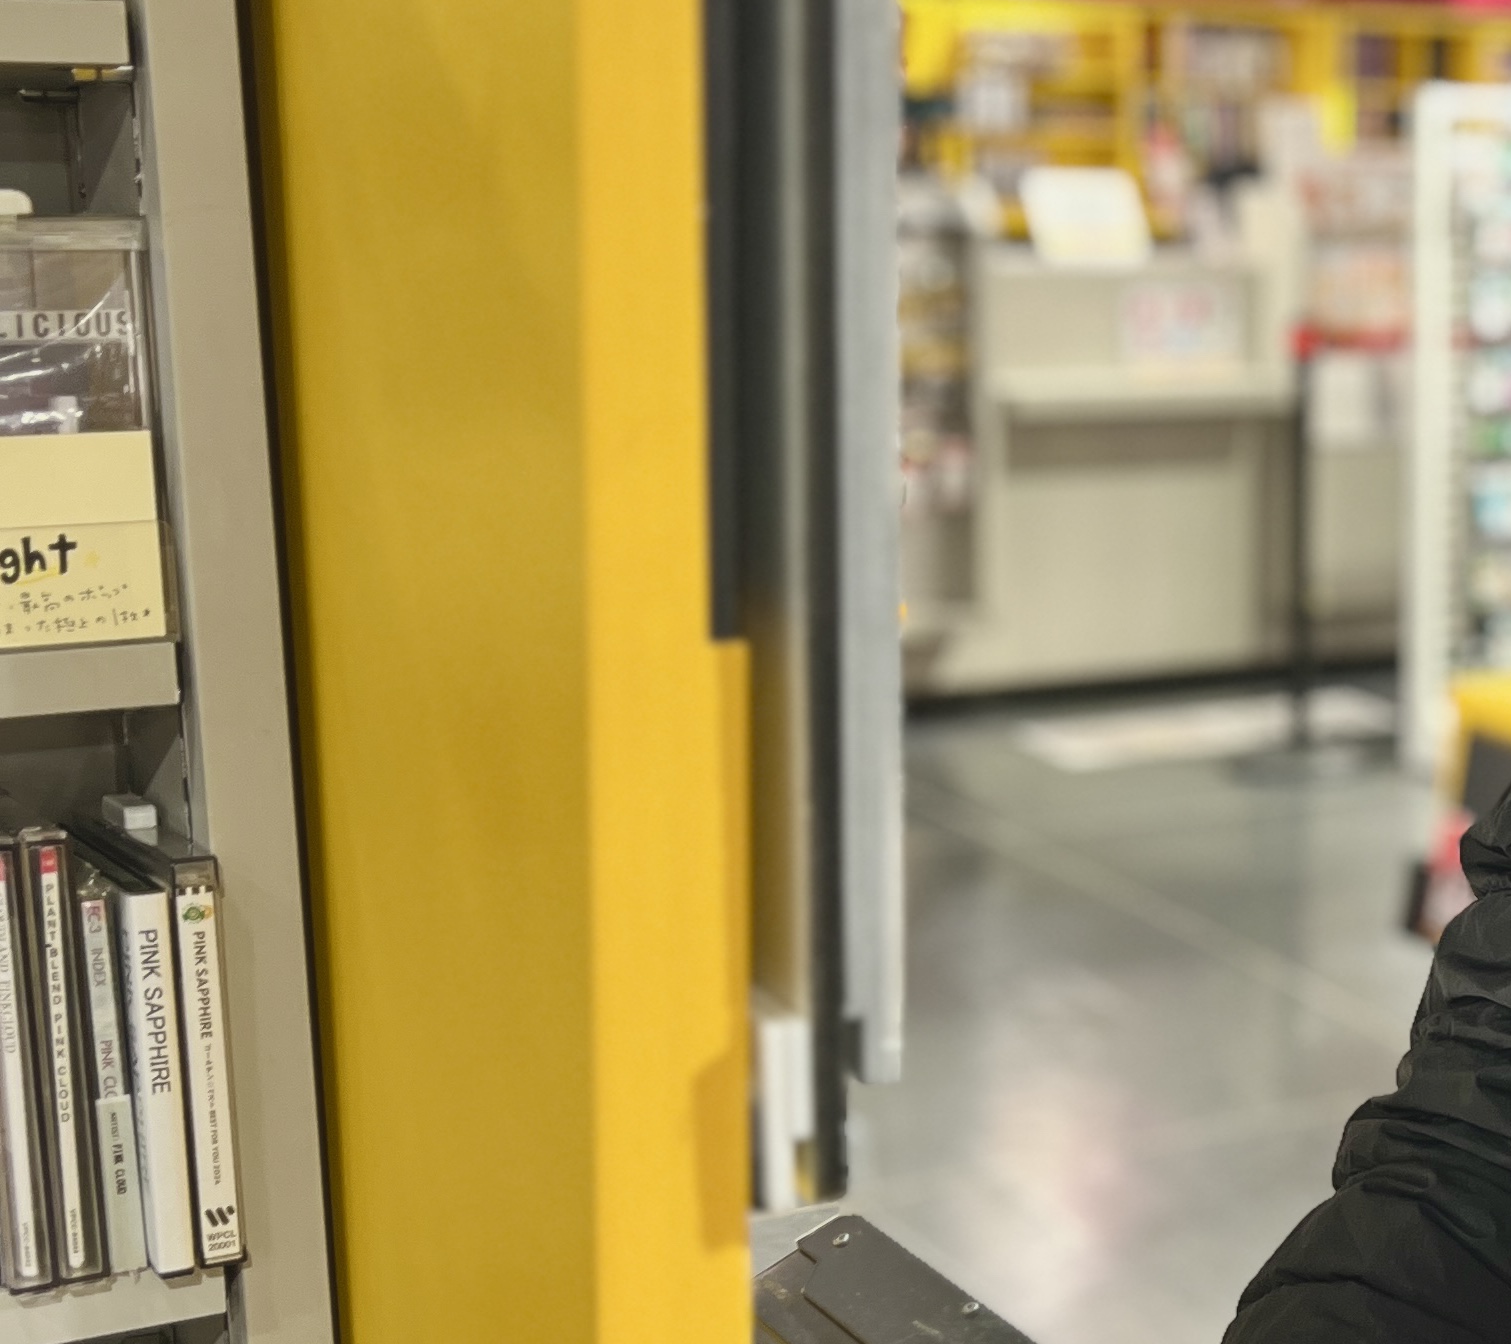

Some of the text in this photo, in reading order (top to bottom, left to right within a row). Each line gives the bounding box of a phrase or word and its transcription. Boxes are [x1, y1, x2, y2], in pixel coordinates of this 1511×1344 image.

[0, 309, 131, 339] ICIOUS
[193, 931, 208, 966] PINK
[138, 928, 172, 1095] PINK SAPPHIRE
[195, 968, 213, 1040] SAPPHIRE
[100, 1040, 116, 1070] PINK
[57, 1066, 70, 1123] CLOUD
[212, 1146, 220, 1163] YOU
